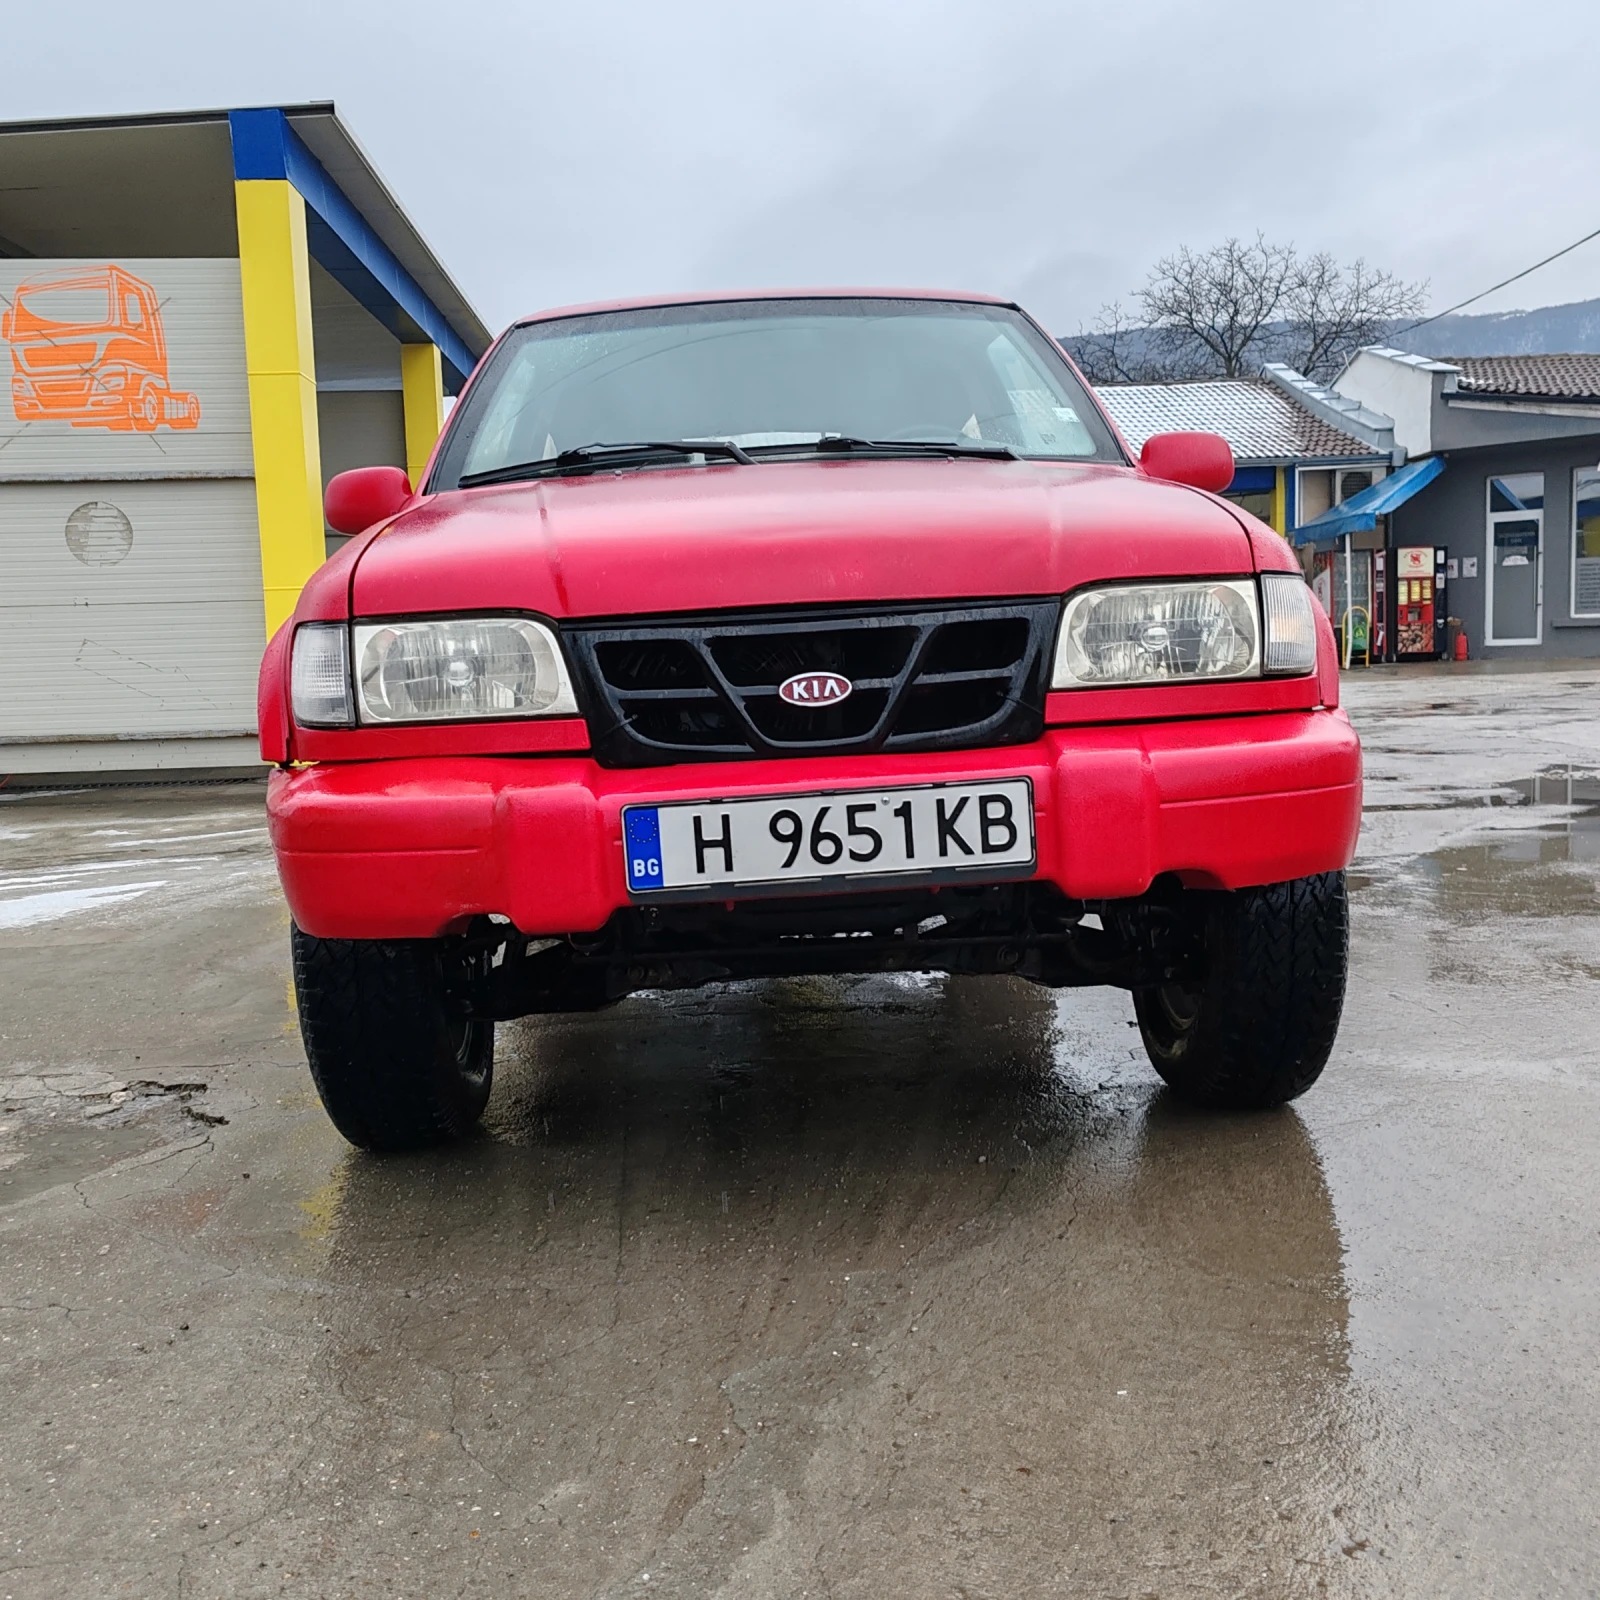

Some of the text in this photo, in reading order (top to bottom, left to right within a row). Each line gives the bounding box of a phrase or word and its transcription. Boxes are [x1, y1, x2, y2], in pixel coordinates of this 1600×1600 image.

[792, 679, 841, 699] KIA
[692, 813, 734, 874] H
[633, 858, 659, 877] BG
